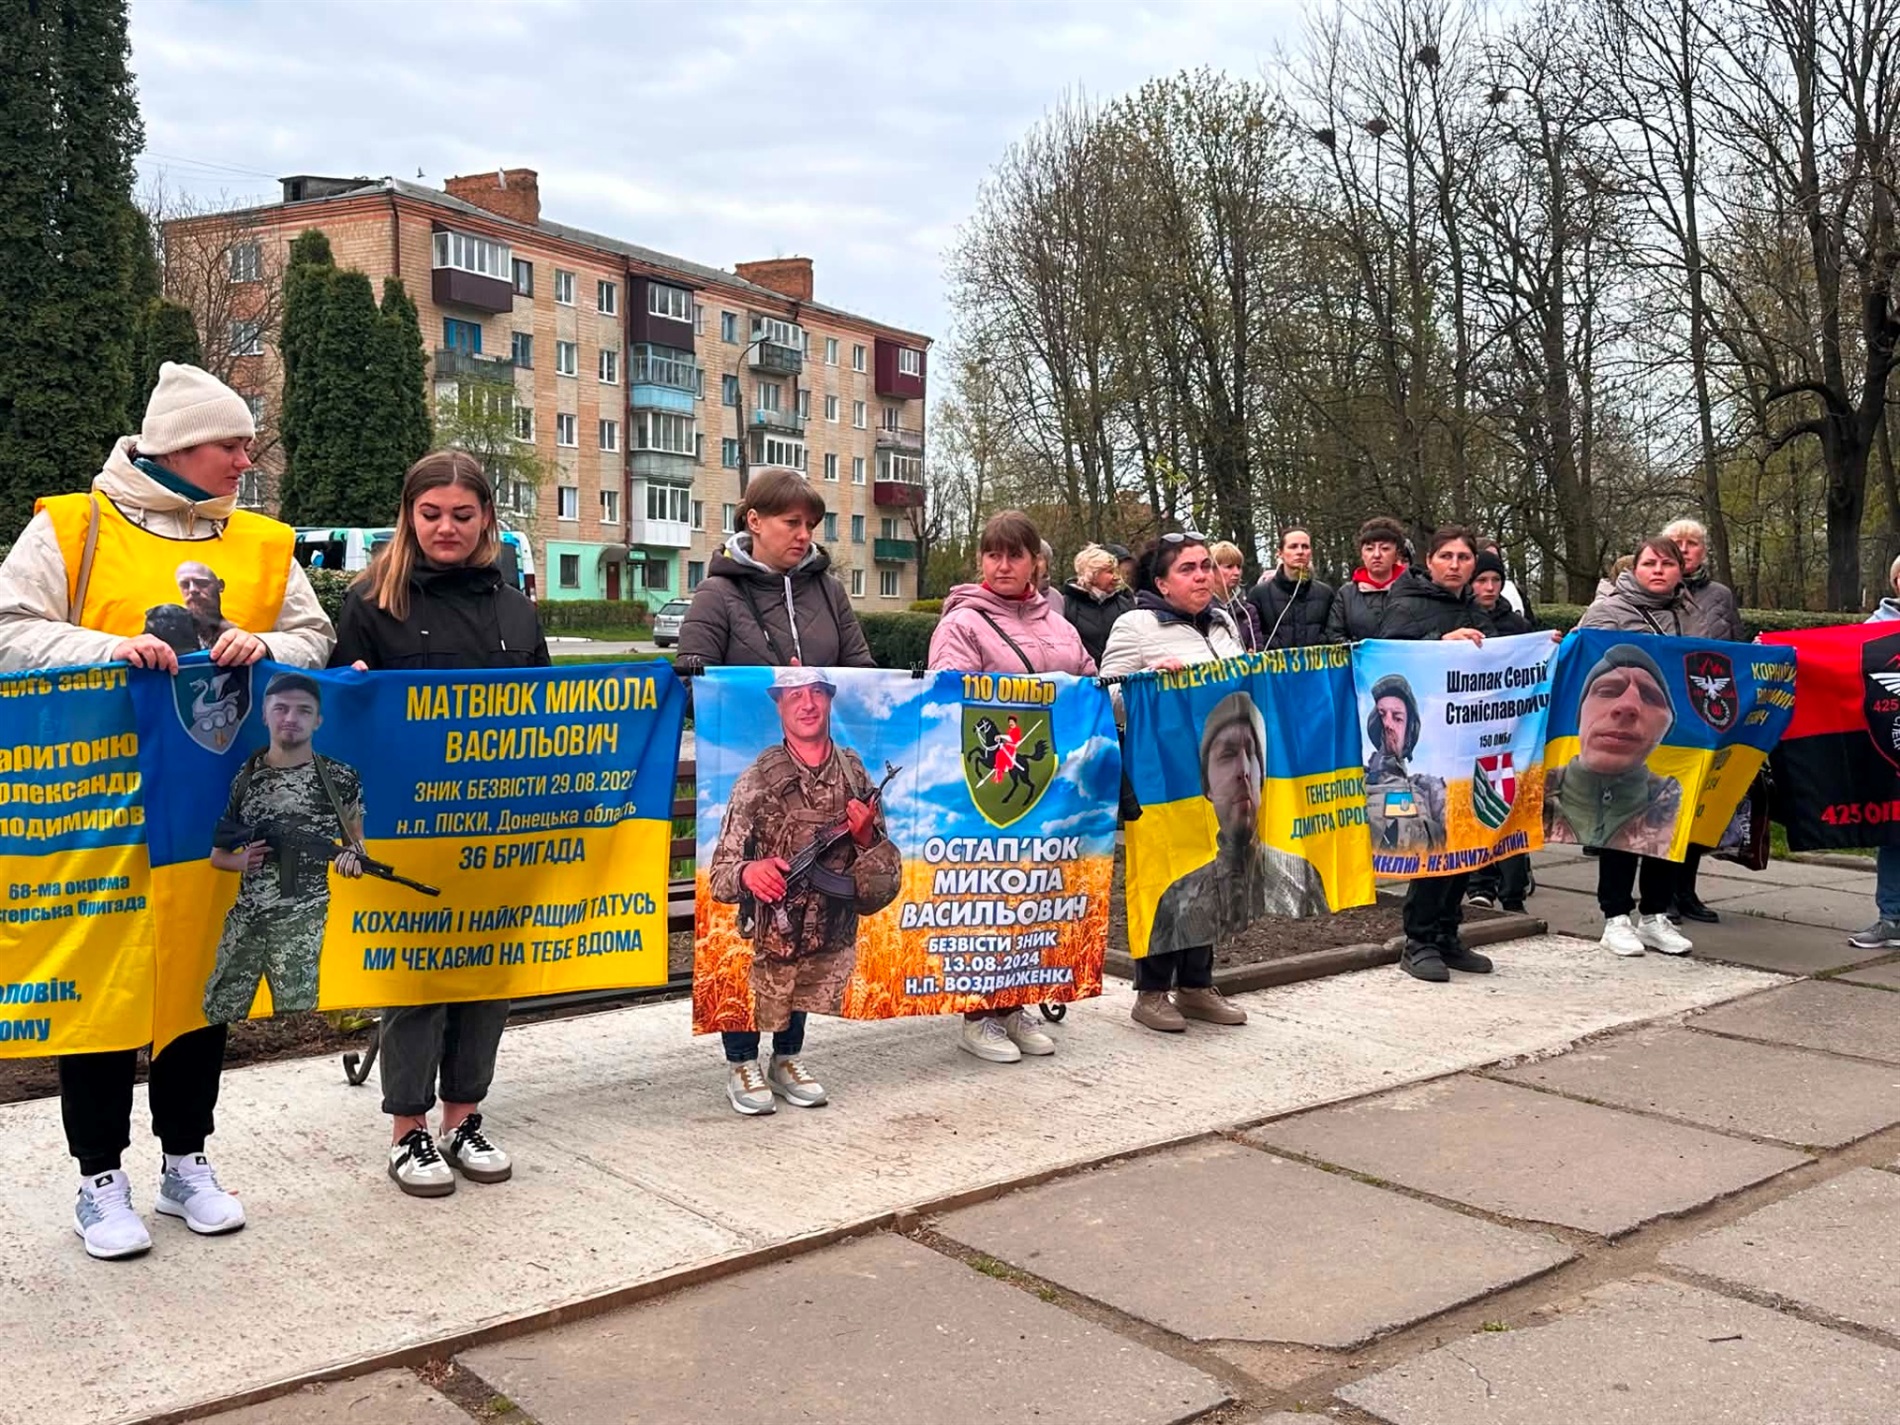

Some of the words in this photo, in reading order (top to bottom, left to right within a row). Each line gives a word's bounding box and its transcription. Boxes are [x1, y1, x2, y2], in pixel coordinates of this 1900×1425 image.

[1446, 670, 1503, 693] Шлапак
[1504, 659, 1549, 689] Сергій
[406, 682, 538, 721] МАТВІЮК
[545, 677, 658, 714] МИКОЛА
[962, 674, 993, 702] 110
[998, 676, 1055, 706] ОМБр
[1873, 700, 1899, 713] 425
[445, 723, 618, 763] ВАСИЛЬОВИЧ
[1479, 735, 1493, 748] 150
[414, 781, 462, 802] ЗНИК
[467, 775, 547, 800] БЕЗВІСТИ
[396, 818, 430, 834] н.п.
[435, 811, 492, 834] ПІСКИ,
[496, 808, 579, 833] Донецька
[1290, 812, 1336, 840] ДМИТРА
[1820, 804, 1862, 826] 425
[458, 845, 487, 870] 36
[493, 838, 585, 869] БРИГАДА
[924, 836, 1080, 863] ОСТАП'ЮК
[1427, 854, 1442, 872] НЕ
[1443, 847, 1488, 871] ЗНАЧИТЬ
[9, 882, 61, 901] 68-ма
[65, 876, 130, 895] окрема
[933, 867, 1064, 896] МИКОЛА
[77, 896, 146, 917] бригада
[352, 907, 451, 933] КОХАНИЙ
[457, 911, 463, 932] І
[468, 899, 586, 932] НАЙКРАЩИЙ
[900, 896, 1088, 930] ВАСИЛЬОВИЧ
[363, 948, 396, 970] МИ
[401, 943, 494, 971] ЧЕКАЄМО
[499, 941, 525, 966] НА
[531, 938, 574, 963] ТЕБЕ
[576, 929, 643, 957] ВДОМА
[928, 936, 1012, 954] БЕЗВІСТИ
[1016, 931, 1058, 951] ЗНИК
[943, 951, 1040, 974] 13.08.2024
[905, 978, 940, 995] Н.П.
[944, 968, 1074, 995] ВОЗДВИЖЕНКА
